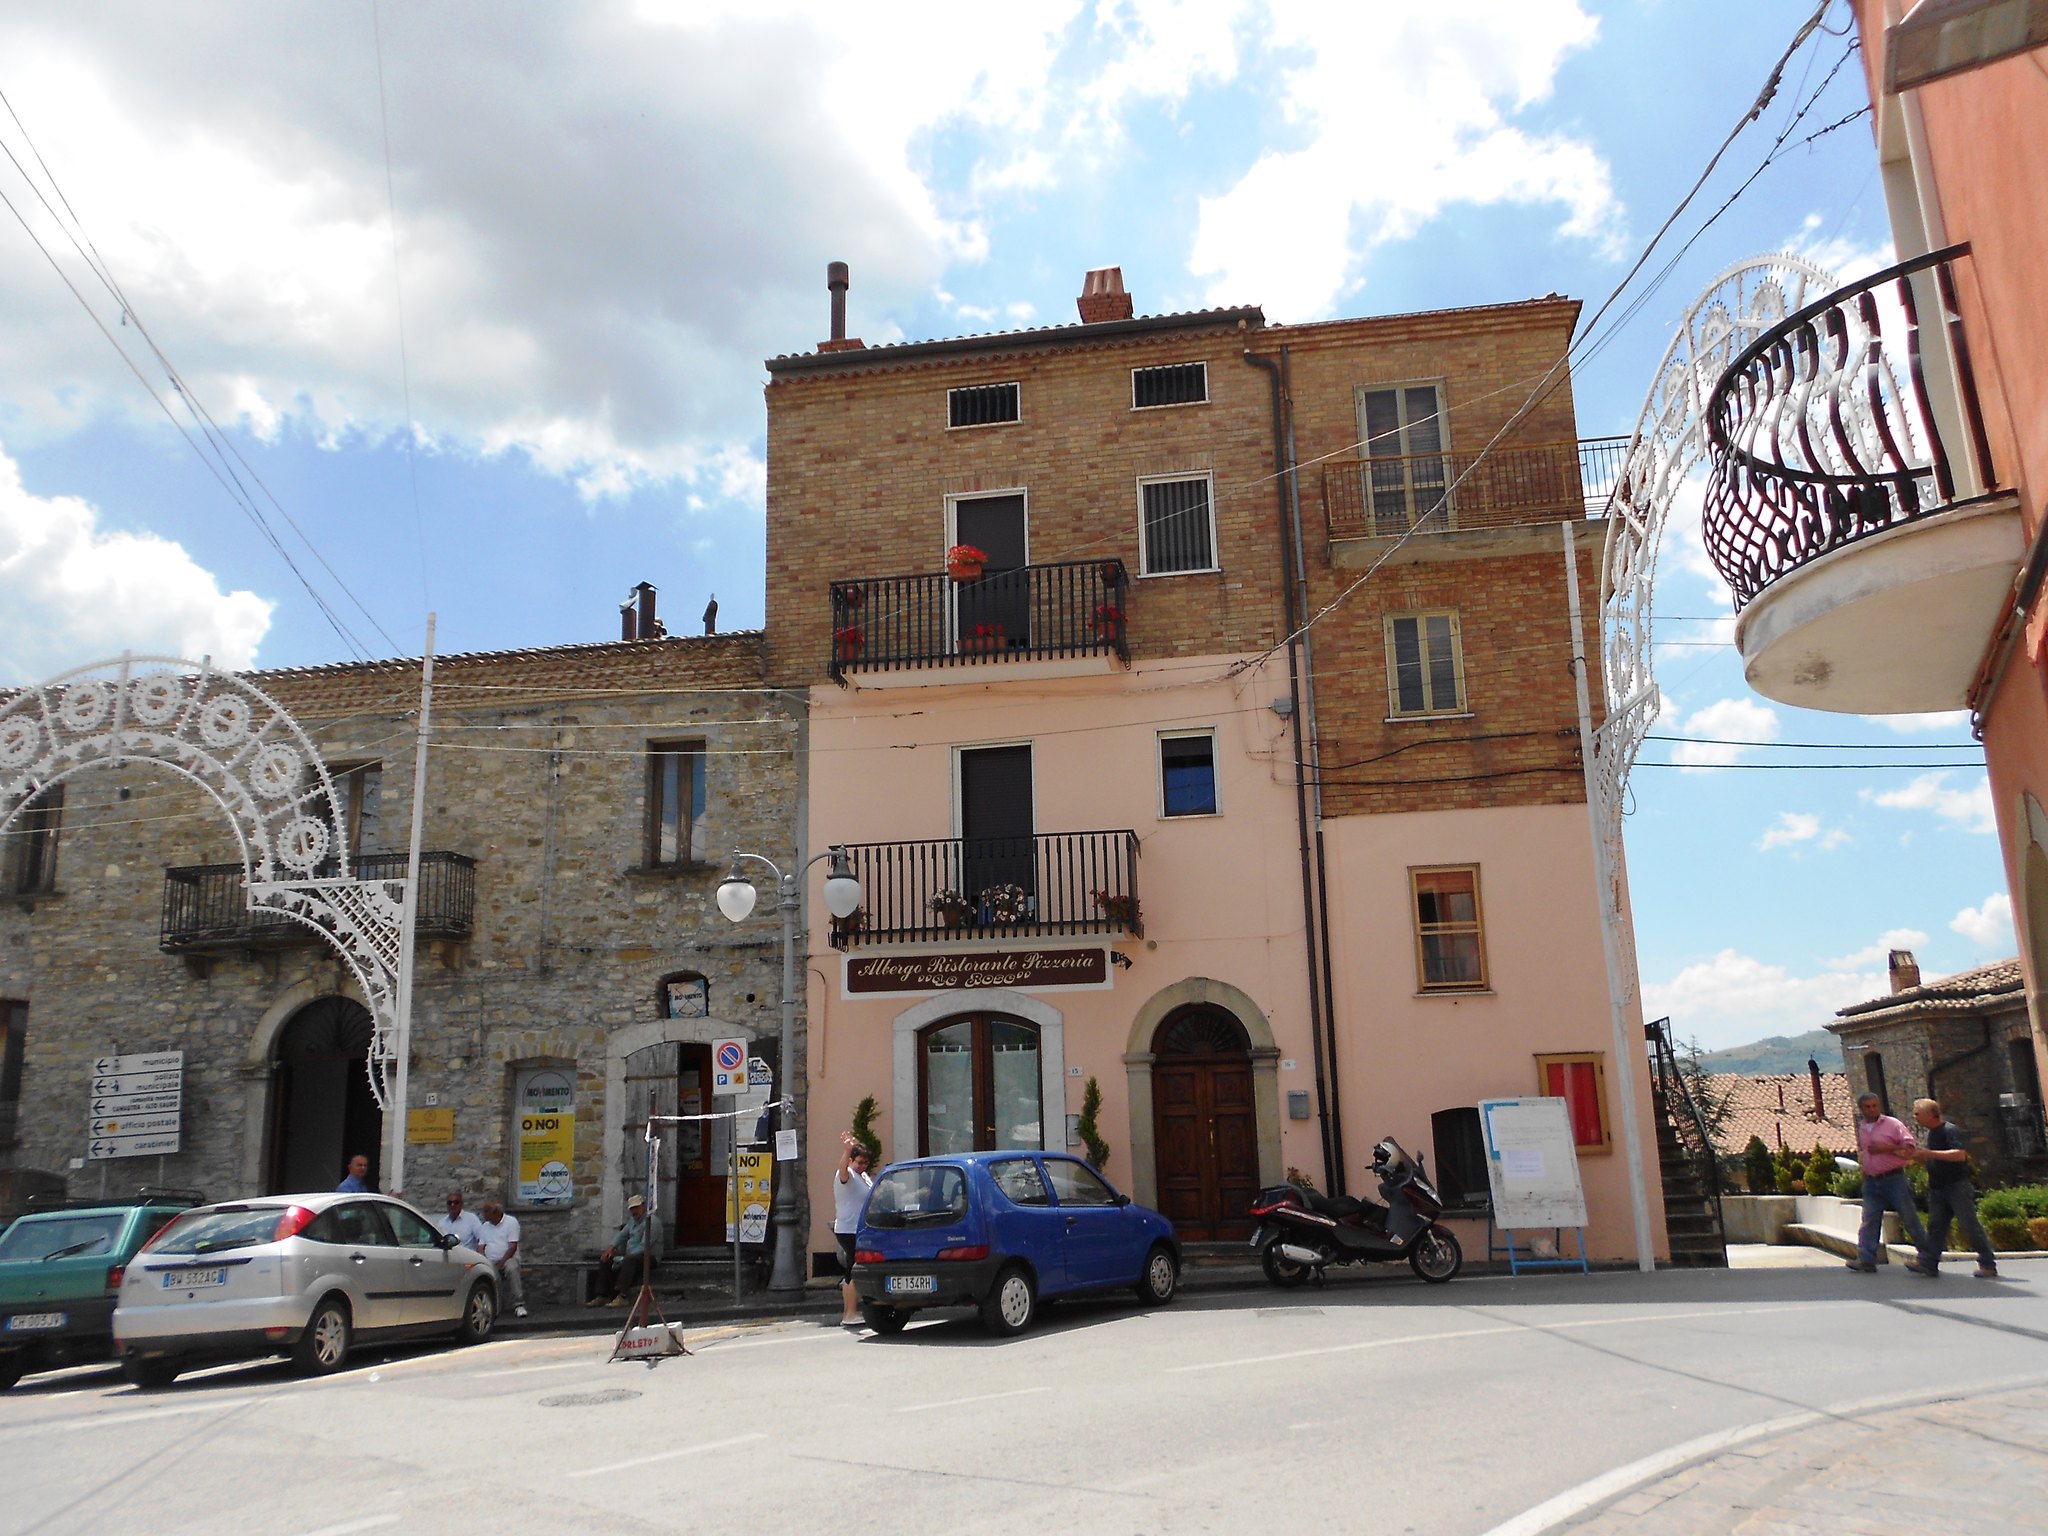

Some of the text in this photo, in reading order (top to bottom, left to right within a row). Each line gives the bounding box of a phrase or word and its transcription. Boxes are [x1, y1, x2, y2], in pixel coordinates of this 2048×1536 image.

[857, 952, 1094, 982] Albergo Ristorante Pizzeria
[674, 992, 703, 1001] MOIMENTO
[142, 1057, 180, 1066] municipio
[154, 1073, 180, 1081] polizia
[718, 1075, 727, 1085] P
[136, 1081, 179, 1091] municipale
[120, 1121, 146, 1130] ufficio
[147, 1119, 177, 1129] postale
[522, 1118, 559, 1130] O NOI
[134, 1140, 177, 1150] carabinieri
[739, 1156, 760, 1168] NOI
[891, 1276, 931, 1289] CE 134RH
